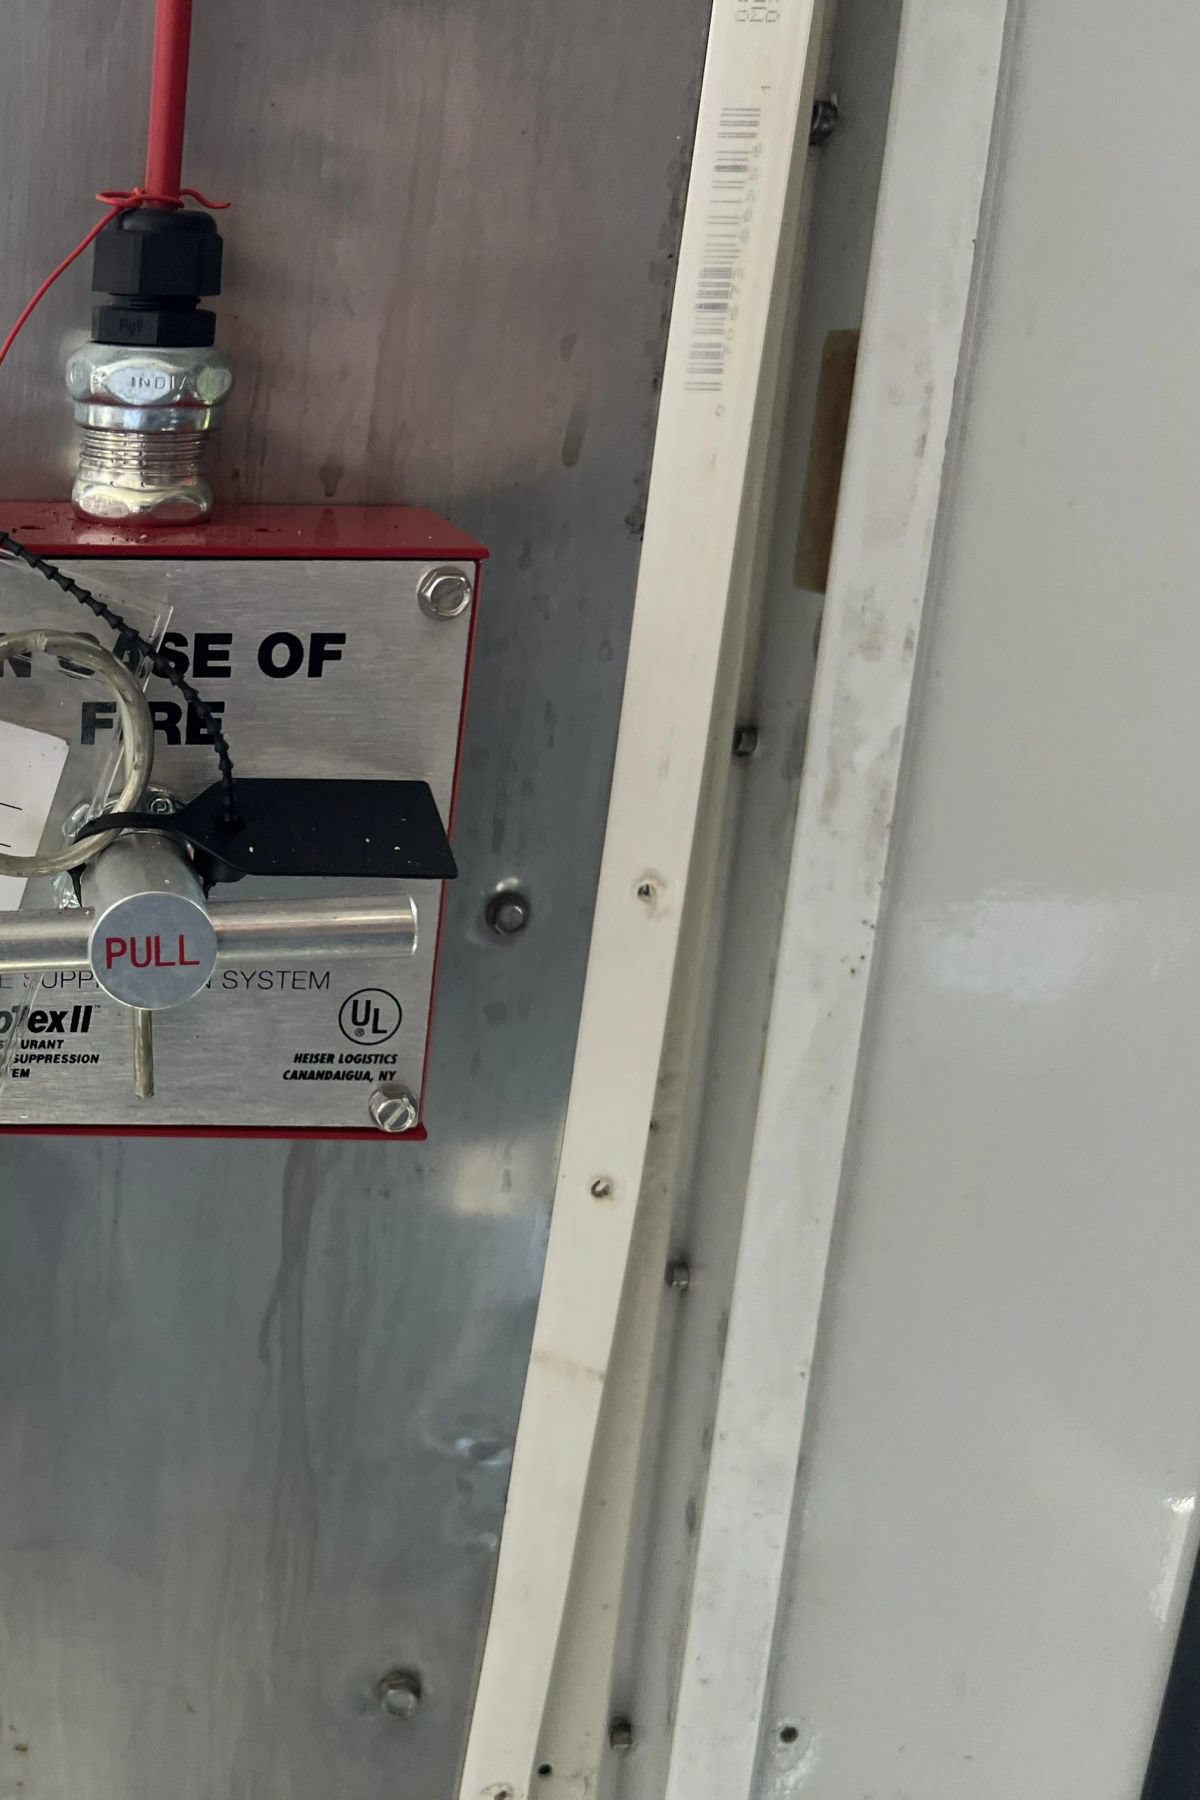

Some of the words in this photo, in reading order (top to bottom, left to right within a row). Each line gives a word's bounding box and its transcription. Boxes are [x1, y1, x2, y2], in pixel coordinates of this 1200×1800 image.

[56, 631, 232, 679] ASE
[257, 631, 347, 679] OF
[81, 701, 225, 745] FRE
[105, 934, 200, 970] PULL
[222, 970, 330, 991] SYSTEM
[351, 999, 388, 1034] UL
[282, 1070, 373, 1083] CANANDAIGUA,
[377, 1071, 397, 1081] NY
[294, 1053, 335, 1064] HEISER
[338, 1053, 398, 1065] LOGISTICS
